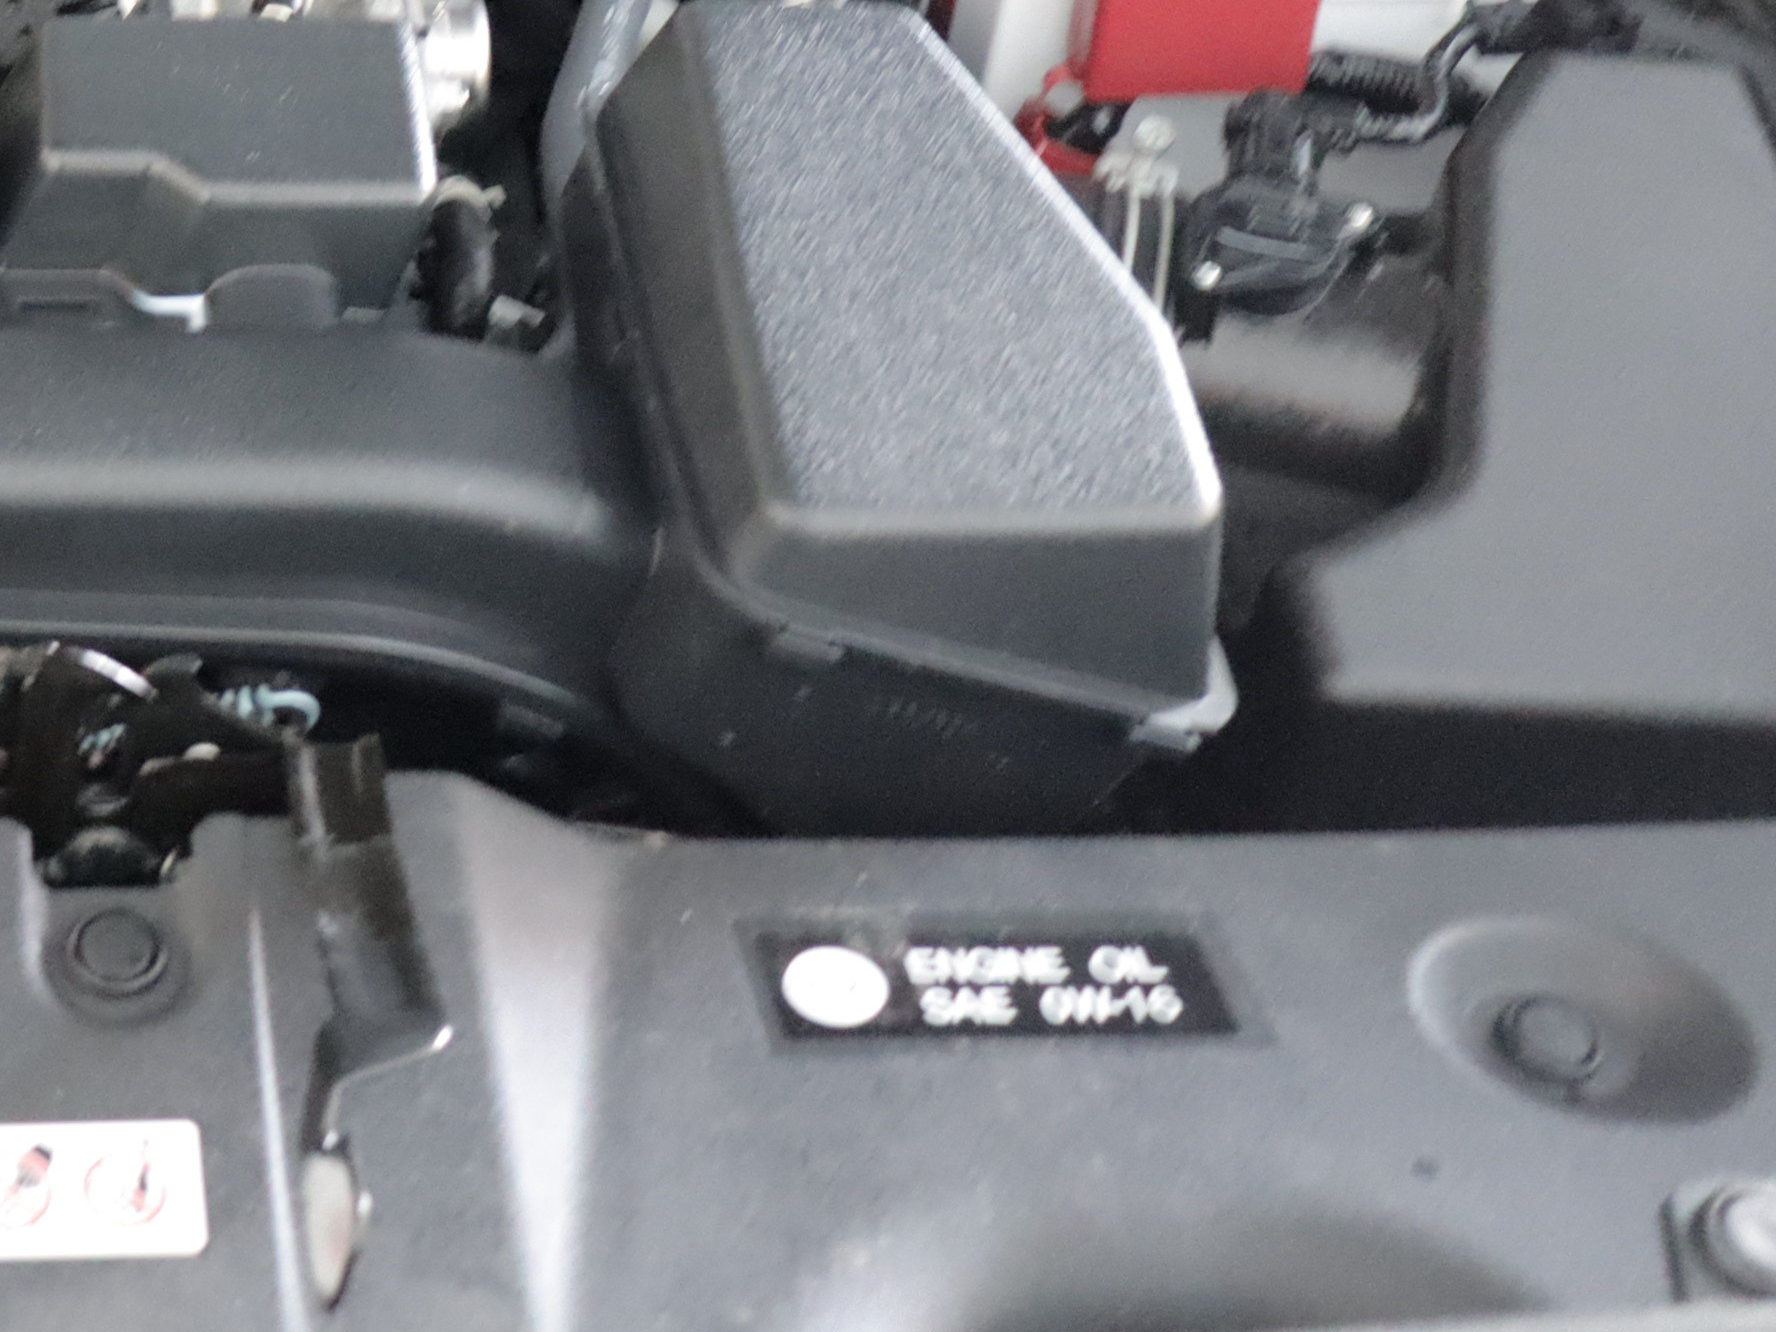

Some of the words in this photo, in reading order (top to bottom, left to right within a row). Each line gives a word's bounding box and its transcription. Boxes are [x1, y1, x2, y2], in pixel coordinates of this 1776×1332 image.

[904, 944, 1070, 984] ENGINE
[1087, 944, 1169, 984] OIL
[919, 984, 1018, 1026] SAE
